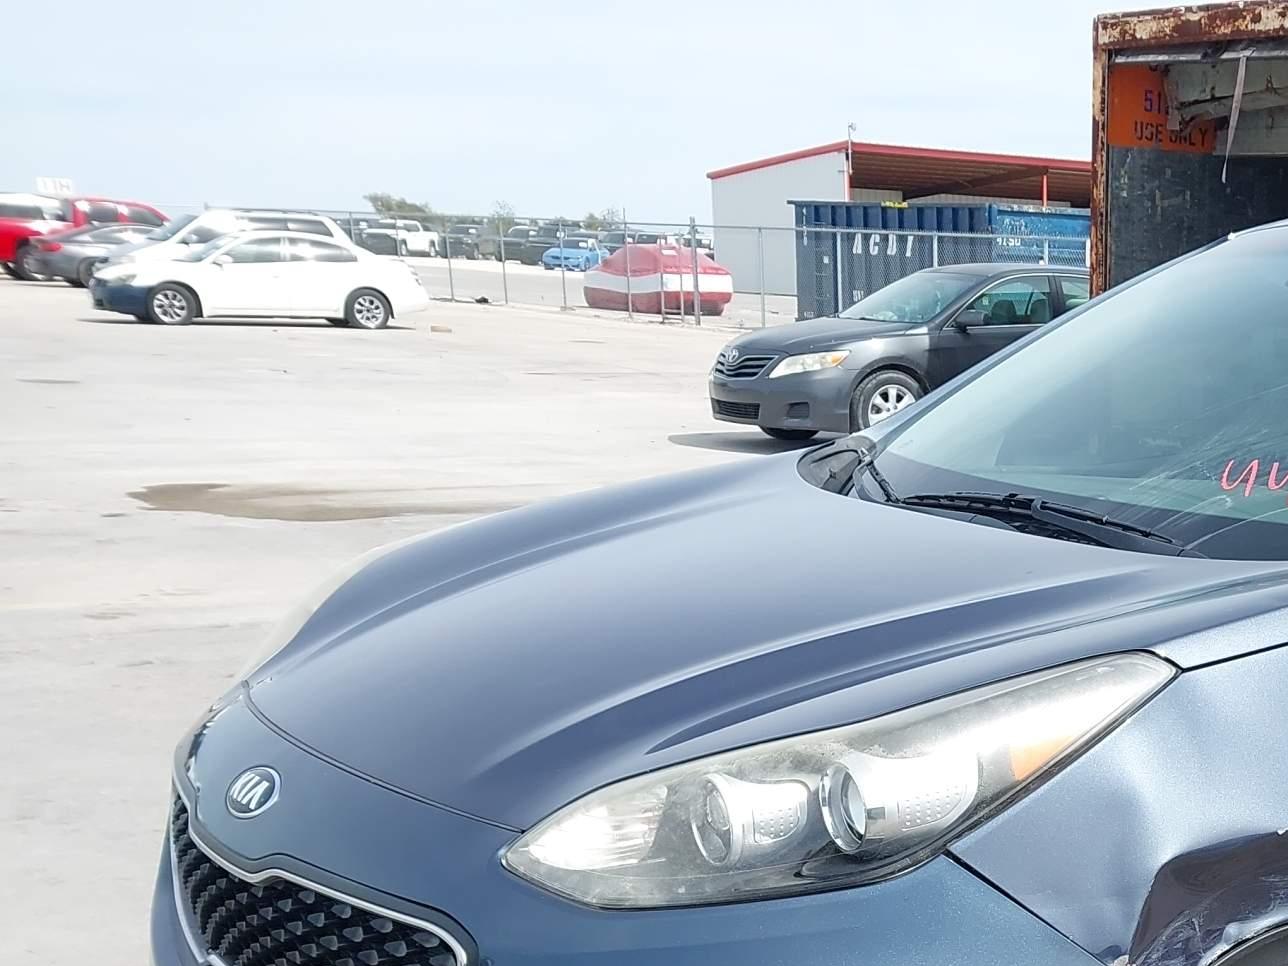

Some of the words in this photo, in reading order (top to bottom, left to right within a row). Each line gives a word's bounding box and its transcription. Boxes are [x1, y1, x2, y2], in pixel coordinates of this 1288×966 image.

[1134, 121, 1163, 142] USE
[1169, 126, 1209, 147] ONLY
[230, 772, 270, 810] KIA
